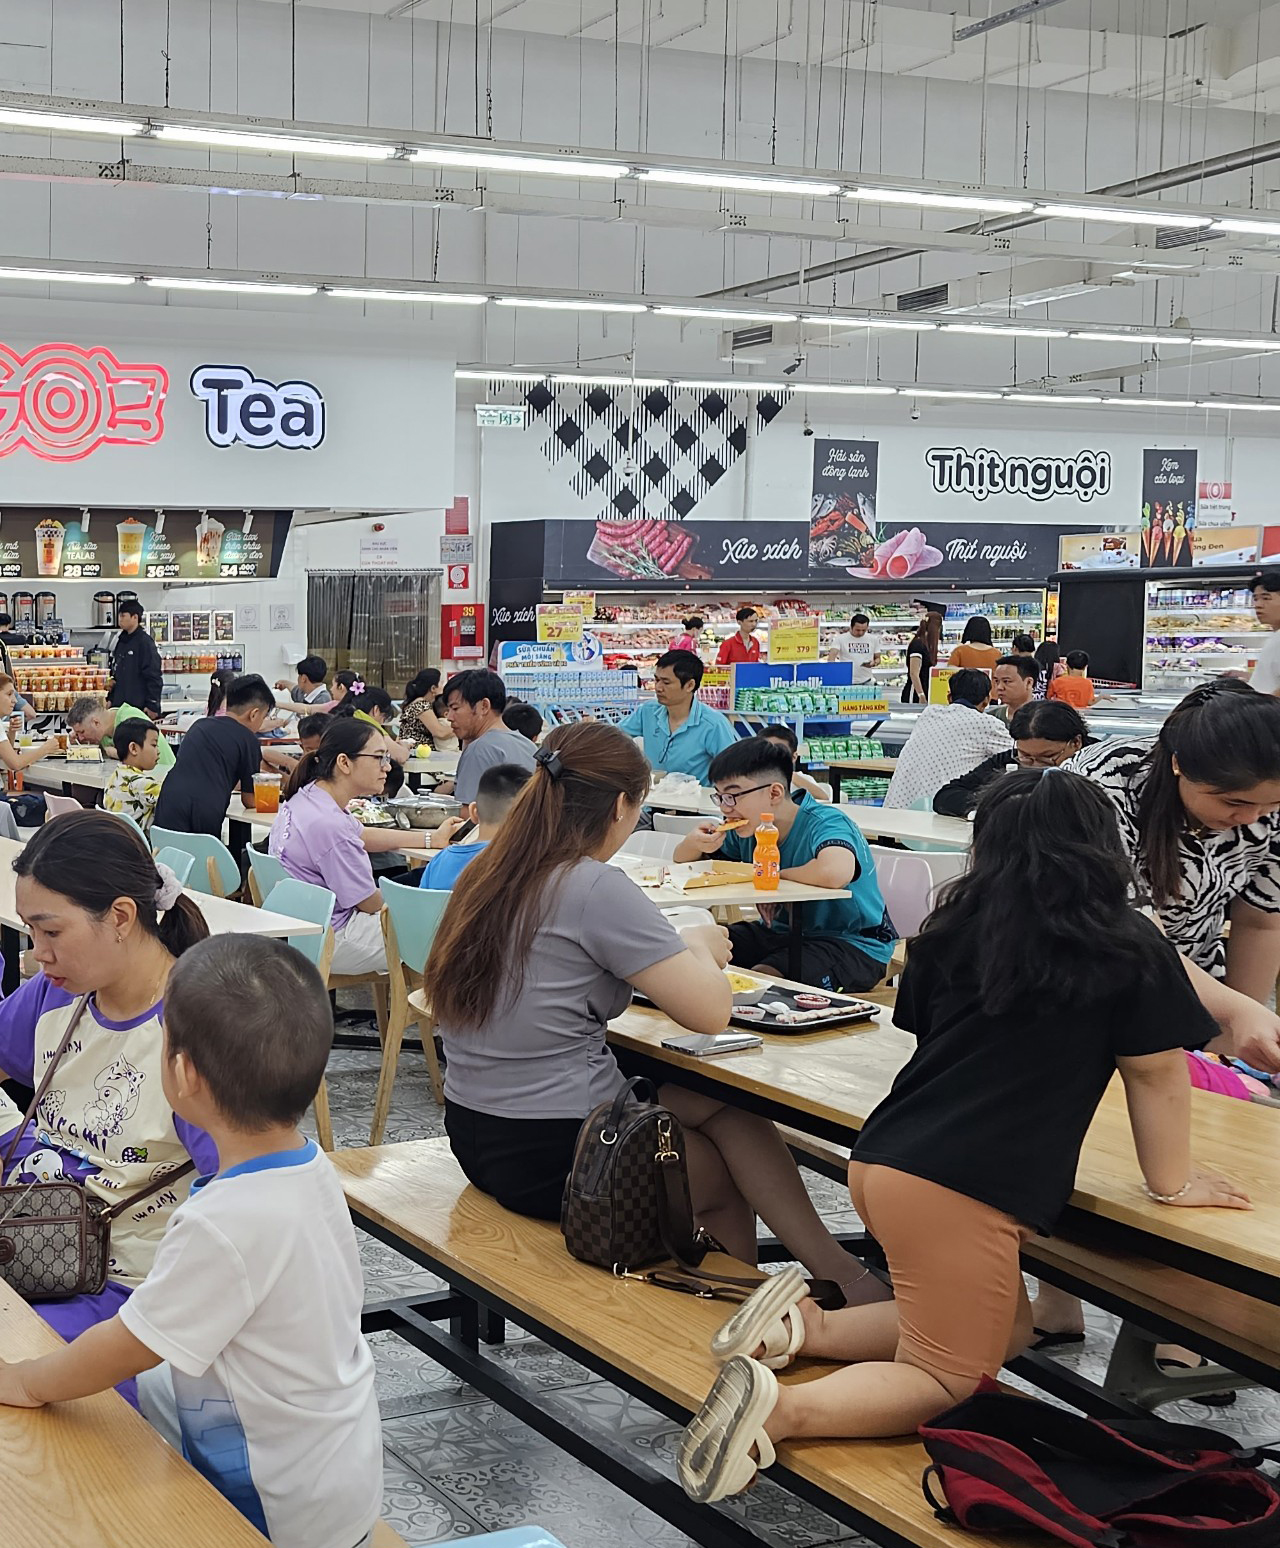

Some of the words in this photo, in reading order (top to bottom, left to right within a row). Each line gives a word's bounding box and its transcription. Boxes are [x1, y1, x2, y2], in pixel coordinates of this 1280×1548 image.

[196, 372, 320, 443] Tea
[828, 448, 847, 463] Hải
[848, 450, 866, 463] sản
[1161, 457, 1180, 472] Kem
[822, 465, 847, 480] đông
[848, 465, 869, 479] lạnh
[1154, 473, 1167, 484] các
[66, 551, 96, 560] TEALAB
[720, 537, 758, 564] Xúc
[762, 537, 802, 561] xích
[946, 538, 979, 563] Thịt
[979, 540, 1027, 567] nguội
[462, 607, 475, 616] 39
[492, 606, 512, 626] Xúc
[513, 606, 536, 623] xích
